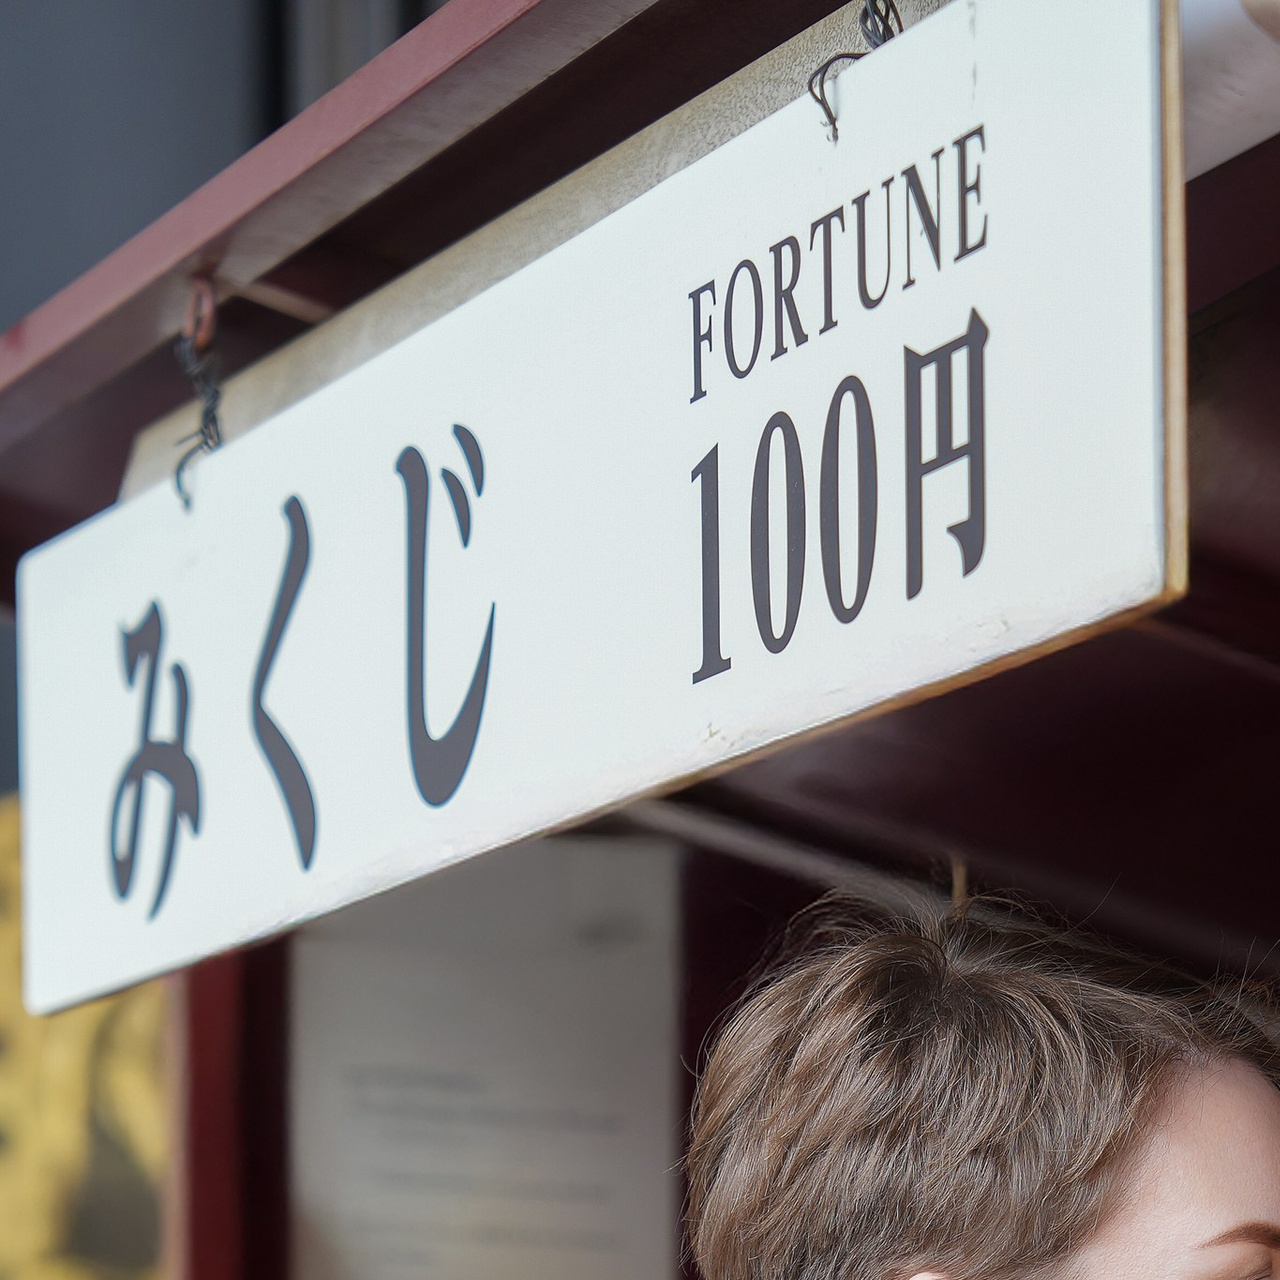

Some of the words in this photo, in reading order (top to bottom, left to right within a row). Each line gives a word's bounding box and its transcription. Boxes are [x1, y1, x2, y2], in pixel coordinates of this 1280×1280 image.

[688, 123, 989, 405] FORTUNE
[109, 423, 496, 921] みくじ
[690, 306, 990, 686] 100円
